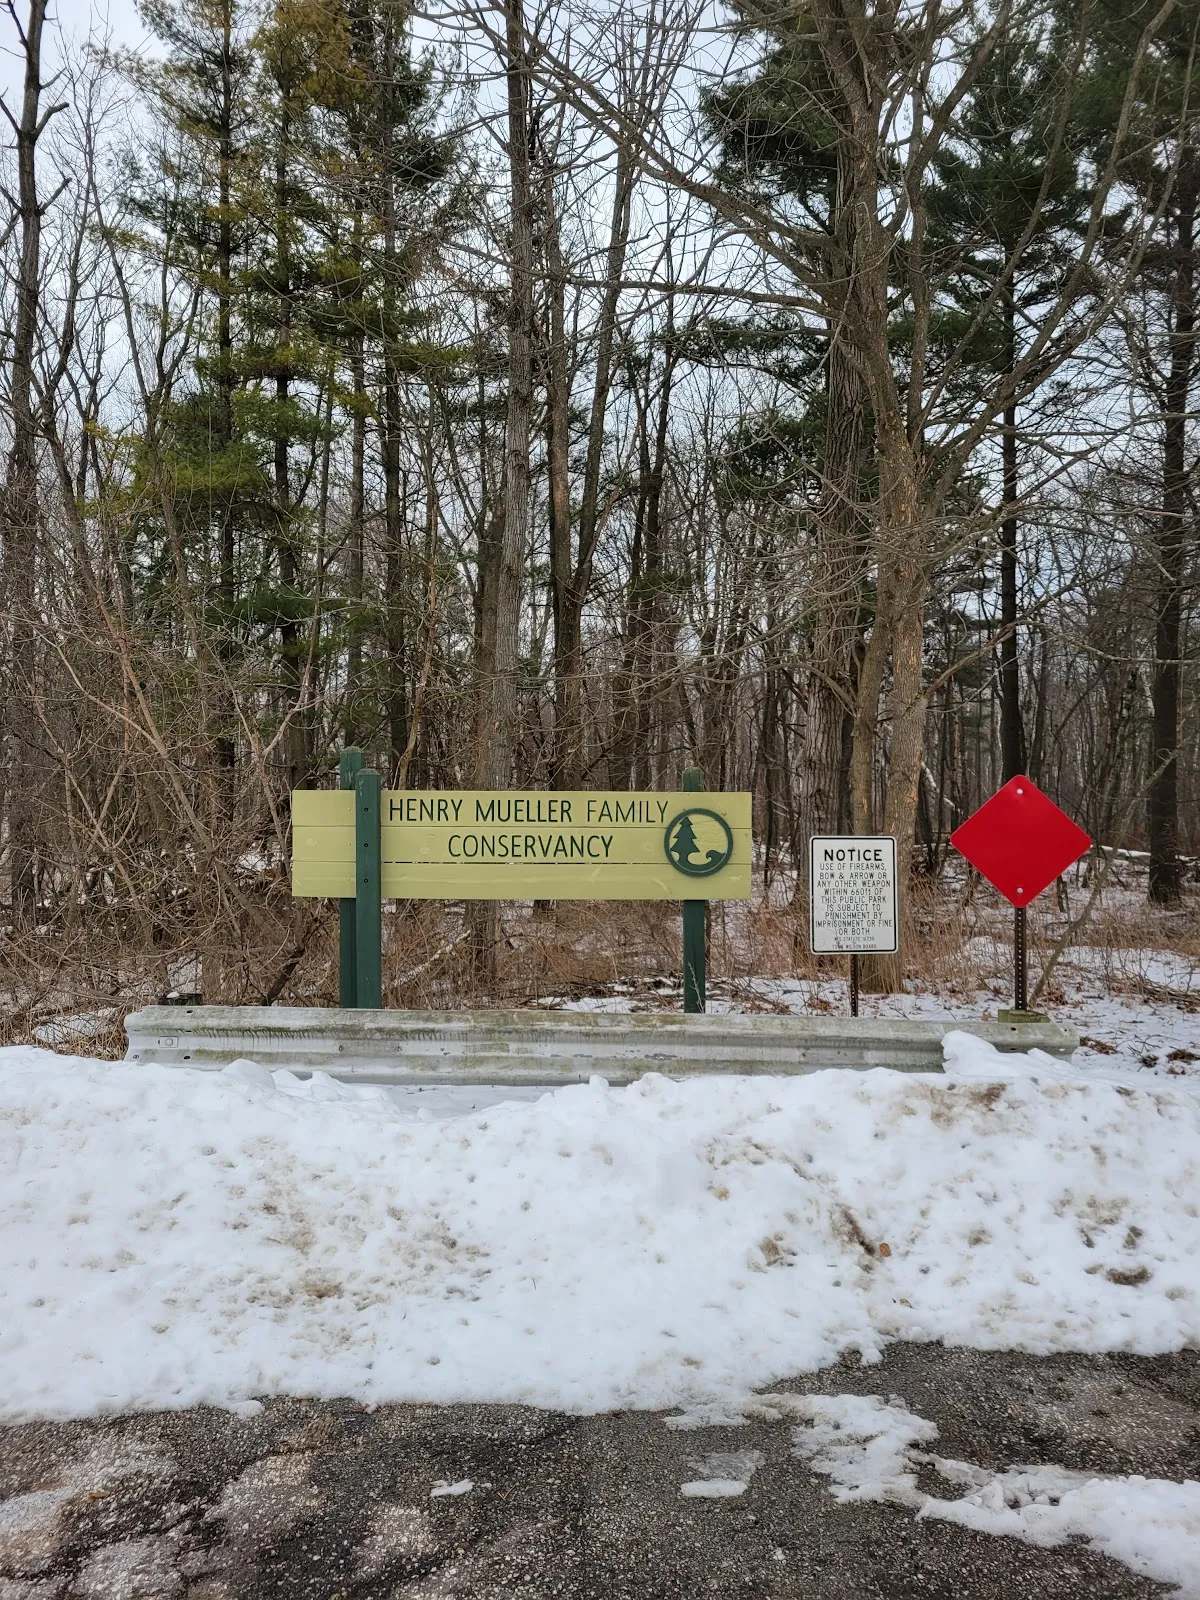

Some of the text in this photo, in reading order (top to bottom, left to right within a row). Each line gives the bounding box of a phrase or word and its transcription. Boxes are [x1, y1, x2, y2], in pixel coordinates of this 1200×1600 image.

[389, 798, 669, 823] HENRY MUELLER FAMILY
[448, 835, 613, 857] CONSERVANCY
[824, 850, 882, 861] NOTICE
